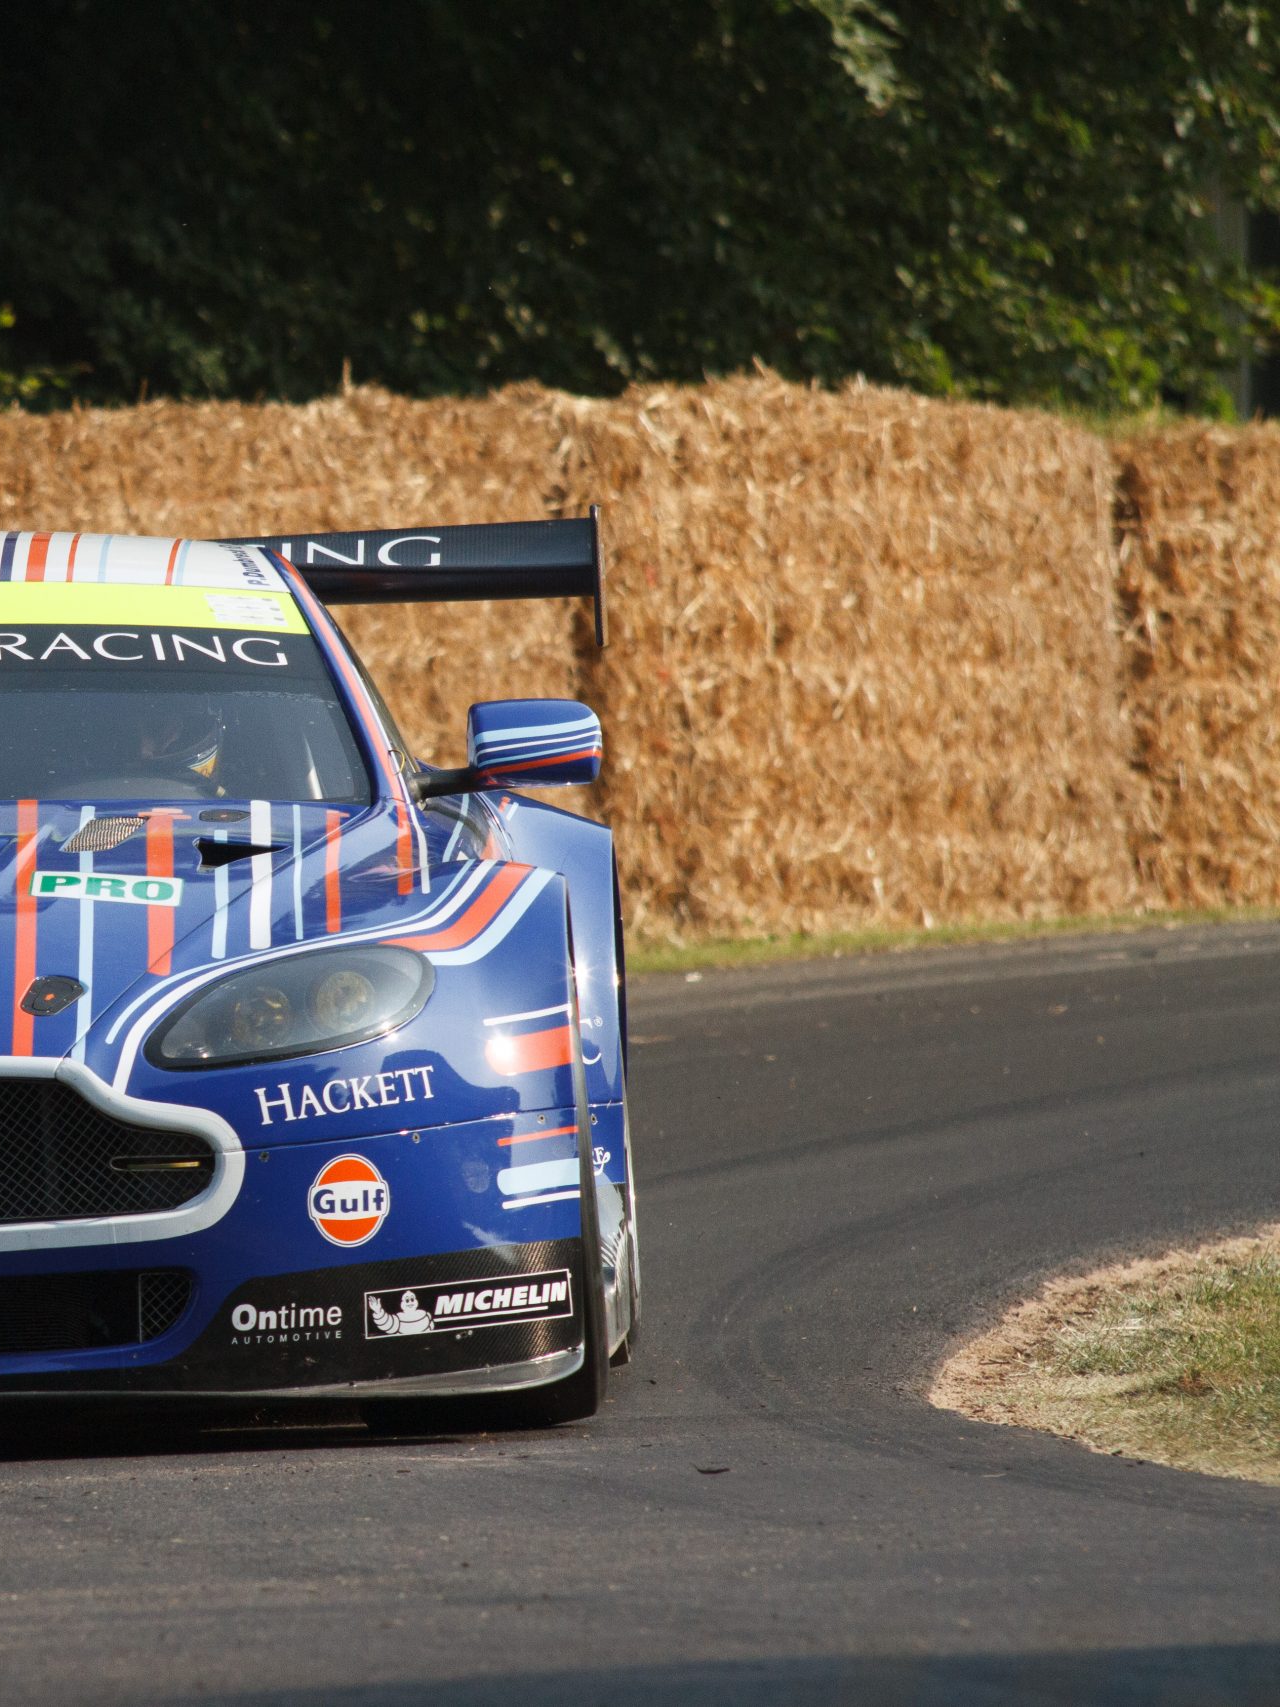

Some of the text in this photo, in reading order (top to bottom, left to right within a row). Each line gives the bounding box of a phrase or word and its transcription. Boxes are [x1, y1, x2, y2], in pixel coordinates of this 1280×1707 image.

[40, 875, 175, 902] PRO
[254, 1065, 435, 1126] HACKETT
[312, 1188, 386, 1215] Gulf
[433, 1280, 568, 1316] MICHELIN
[231, 1302, 343, 1332] Ontime
[231, 1329, 343, 1345] AUTOMOTIVE
